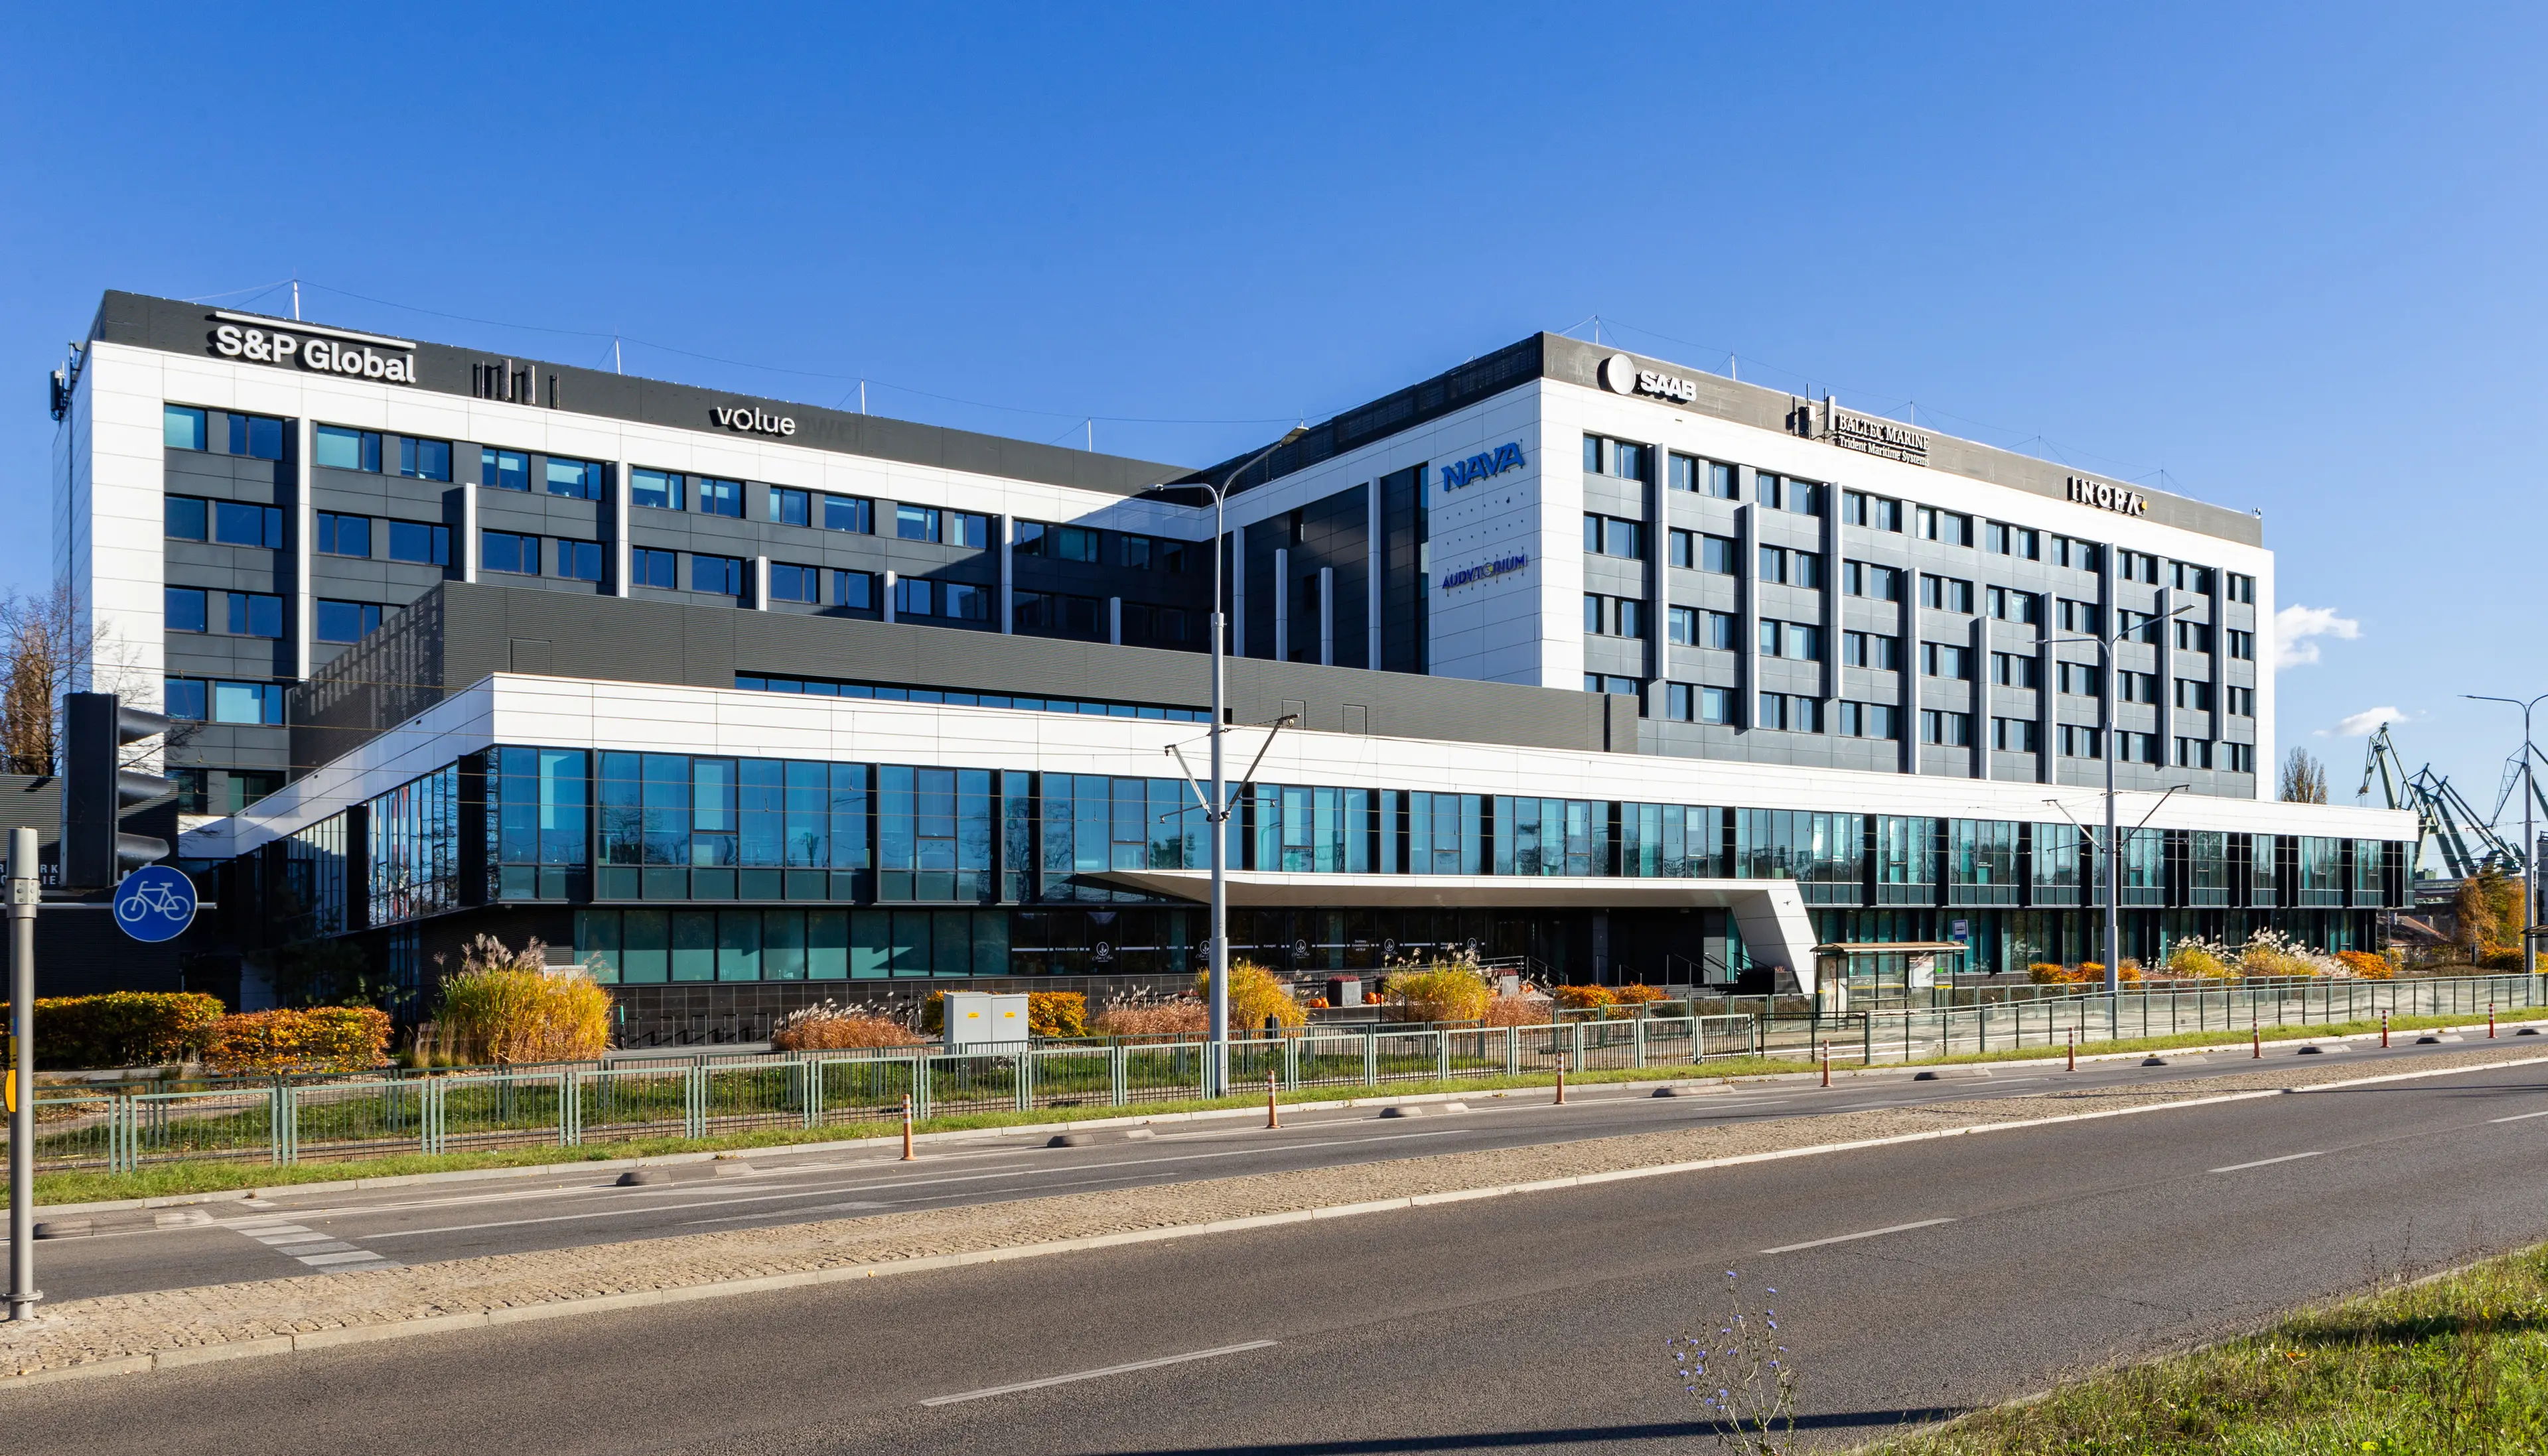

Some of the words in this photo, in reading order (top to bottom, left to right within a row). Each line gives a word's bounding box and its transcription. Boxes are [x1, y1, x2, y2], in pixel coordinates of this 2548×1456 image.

[216, 326, 298, 362] S&P
[303, 340, 417, 383] Global
[1640, 369, 1697, 401] SAAB
[717, 407, 796, 435] volue
[1839, 413, 1884, 440] BALTEC
[1885, 425, 1930, 450] MARINE
[1441, 442, 1526, 492] NAVA
[1839, 435, 1868, 452] Trident
[1868, 442, 1901, 460] Maritime
[1902, 450, 1930, 467] Systems
[1441, 553, 1528, 589] AUDYTORIUM
